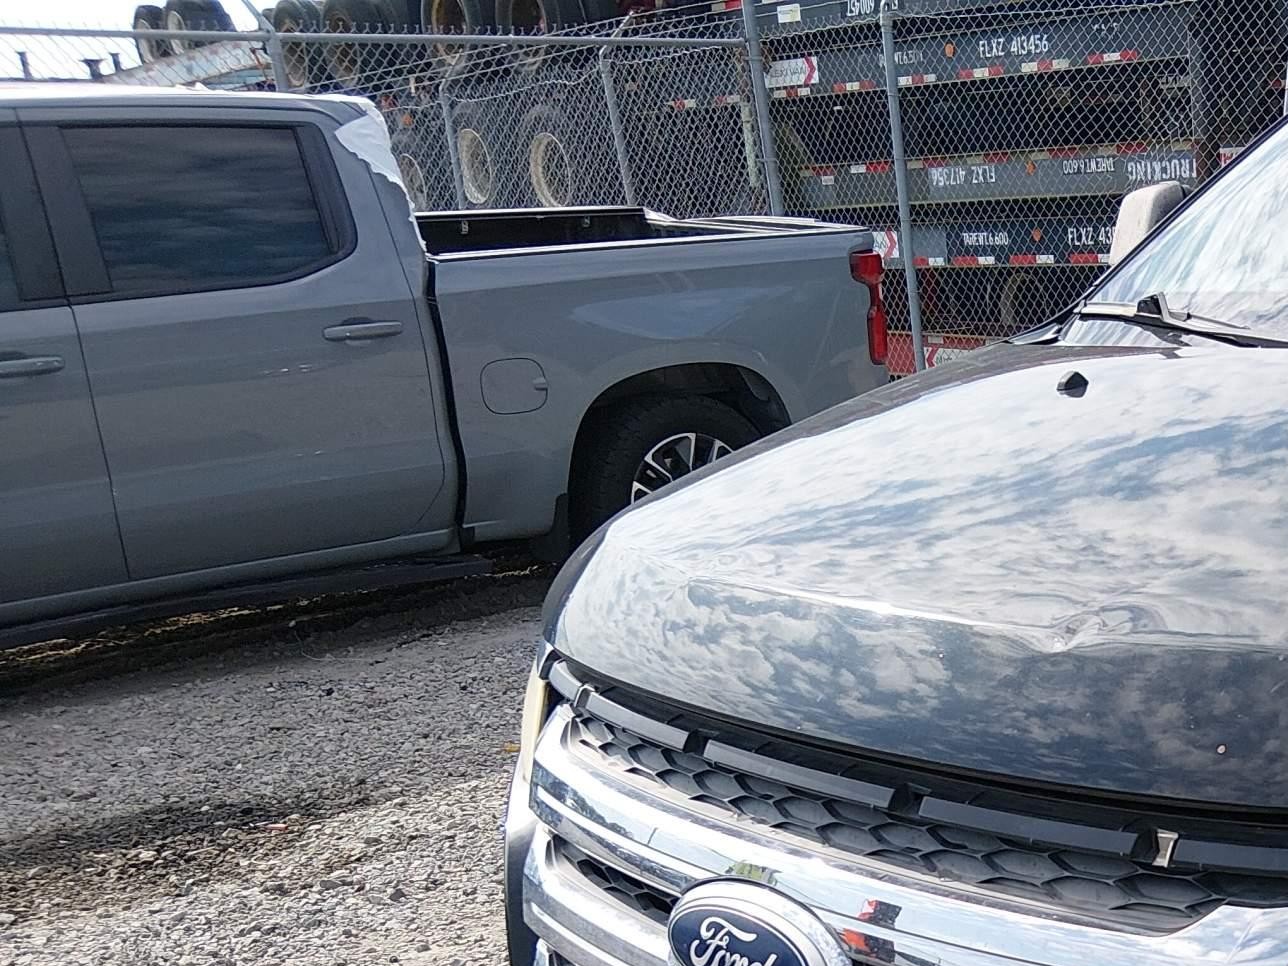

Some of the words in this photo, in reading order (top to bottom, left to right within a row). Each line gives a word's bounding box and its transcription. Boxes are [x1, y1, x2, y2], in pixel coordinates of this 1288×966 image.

[979, 38, 1005, 58] FLXZ
[1010, 34, 1049, 56] 413456
[971, 165, 996, 184] FLXZ
[1067, 227, 1095, 246] FLXZ
